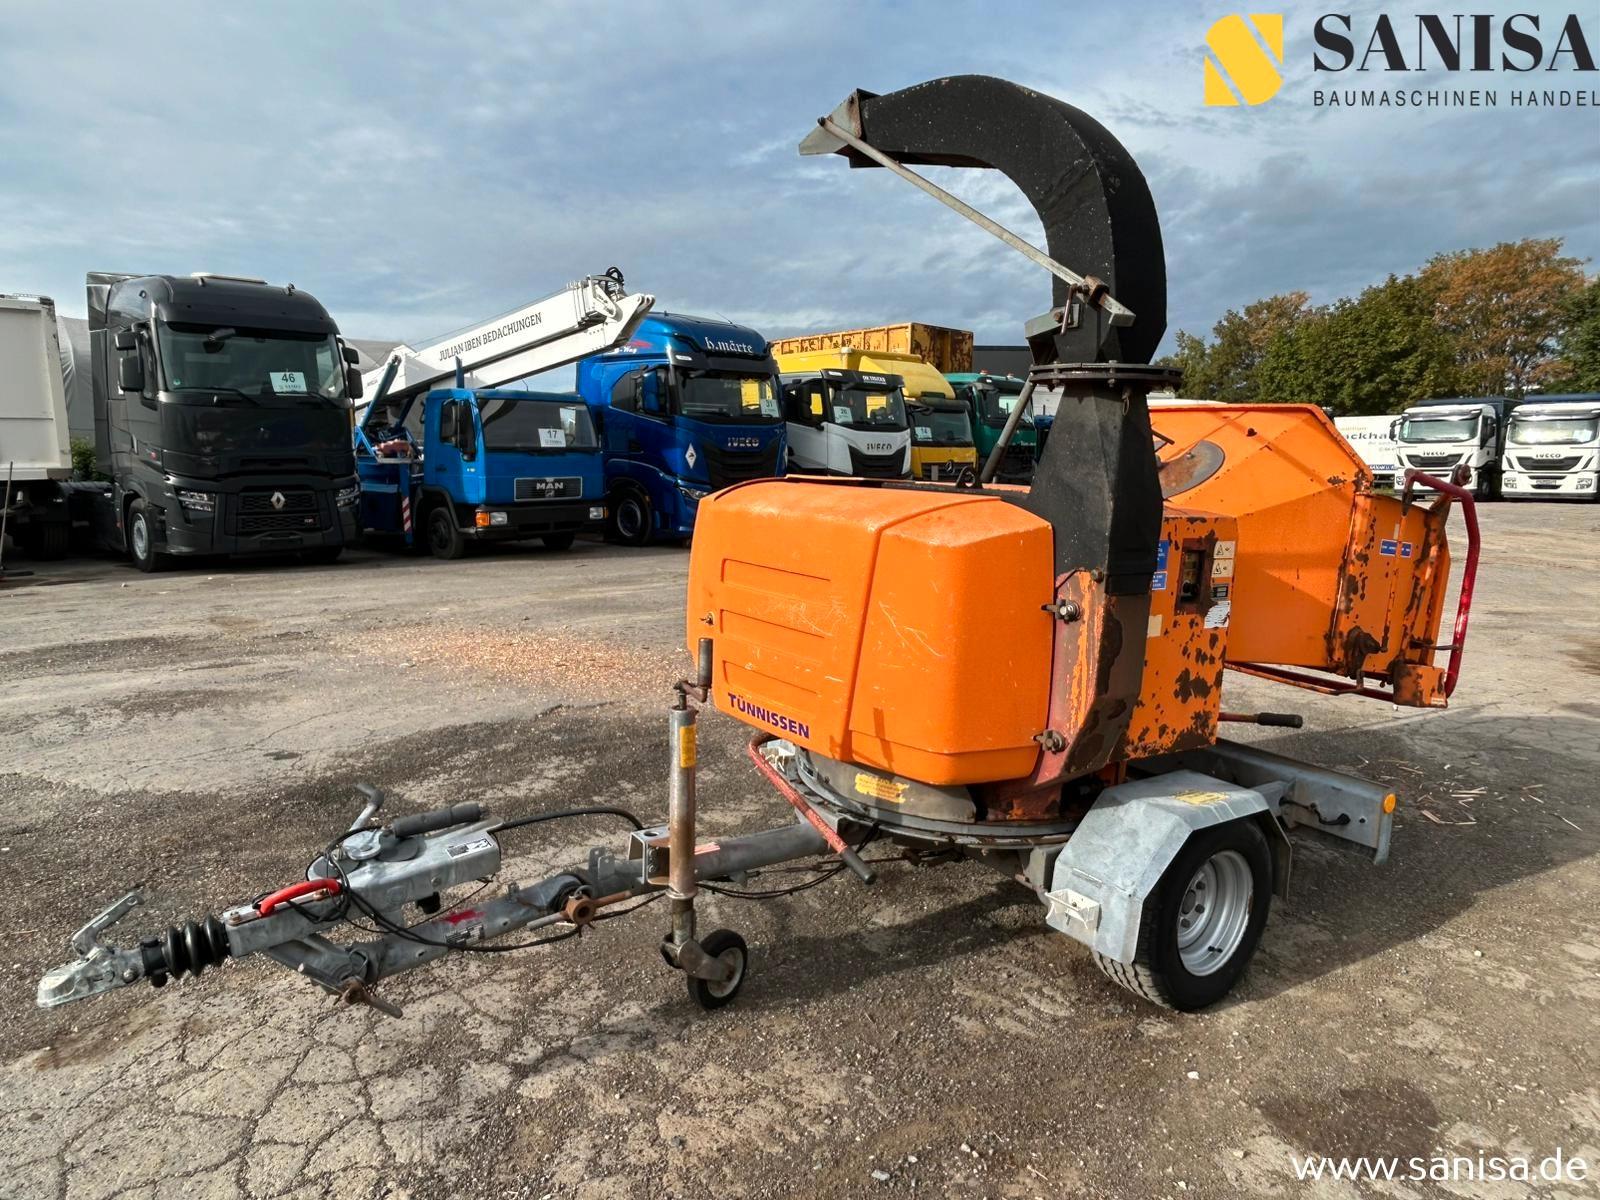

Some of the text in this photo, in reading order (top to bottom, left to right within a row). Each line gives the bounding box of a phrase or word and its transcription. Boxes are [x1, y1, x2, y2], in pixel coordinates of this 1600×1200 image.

[440, 312, 542, 361] JULIAN IBEN BEDACHUNGEN
[281, 373, 296, 383] 46
[547, 430, 558, 439] 17
[1345, 432, 1389, 440] ckha
[728, 437, 760, 447] IVECO
[866, 443, 893, 451] IVECO
[536, 482, 564, 490] MAN
[727, 692, 811, 739] TÜNNISSEN
